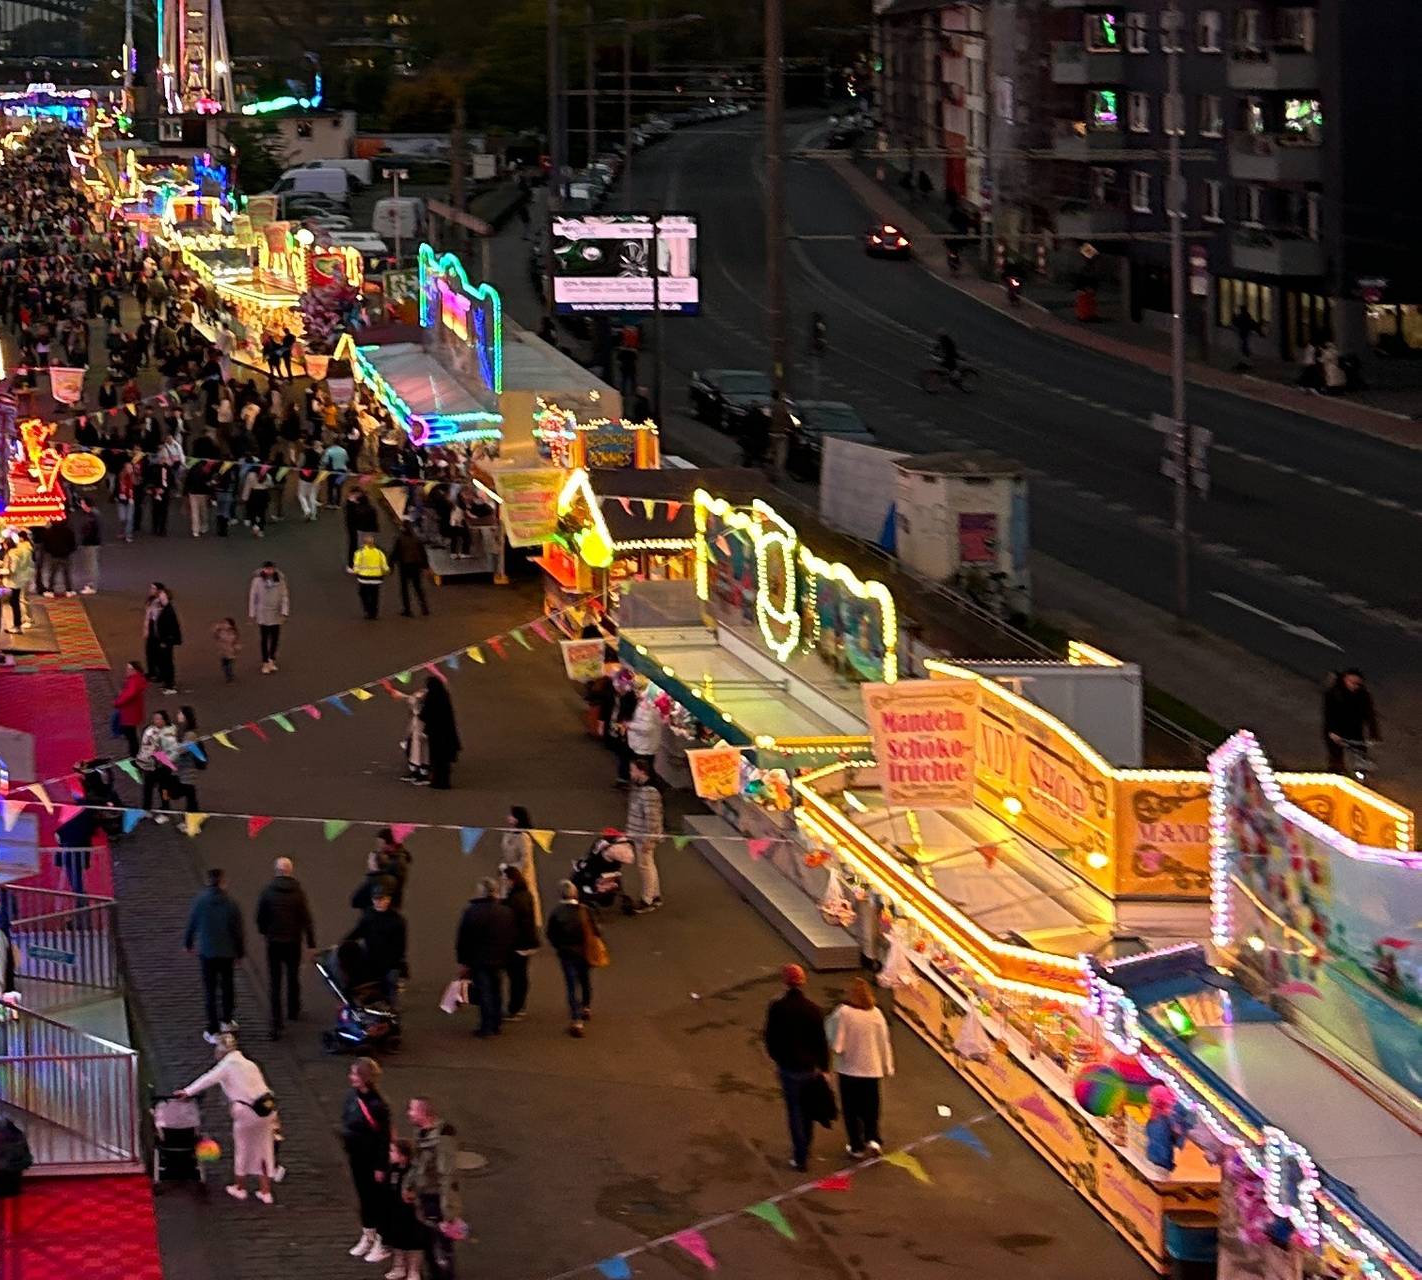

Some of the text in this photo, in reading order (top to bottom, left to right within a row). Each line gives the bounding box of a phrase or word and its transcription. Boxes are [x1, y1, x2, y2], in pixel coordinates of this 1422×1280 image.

[881, 709, 967, 733] Mandeln
[887, 738, 974, 760] Schoko-
[977, 722, 1088, 813] NDY SHOP
[1137, 822, 1210, 844] MAND
